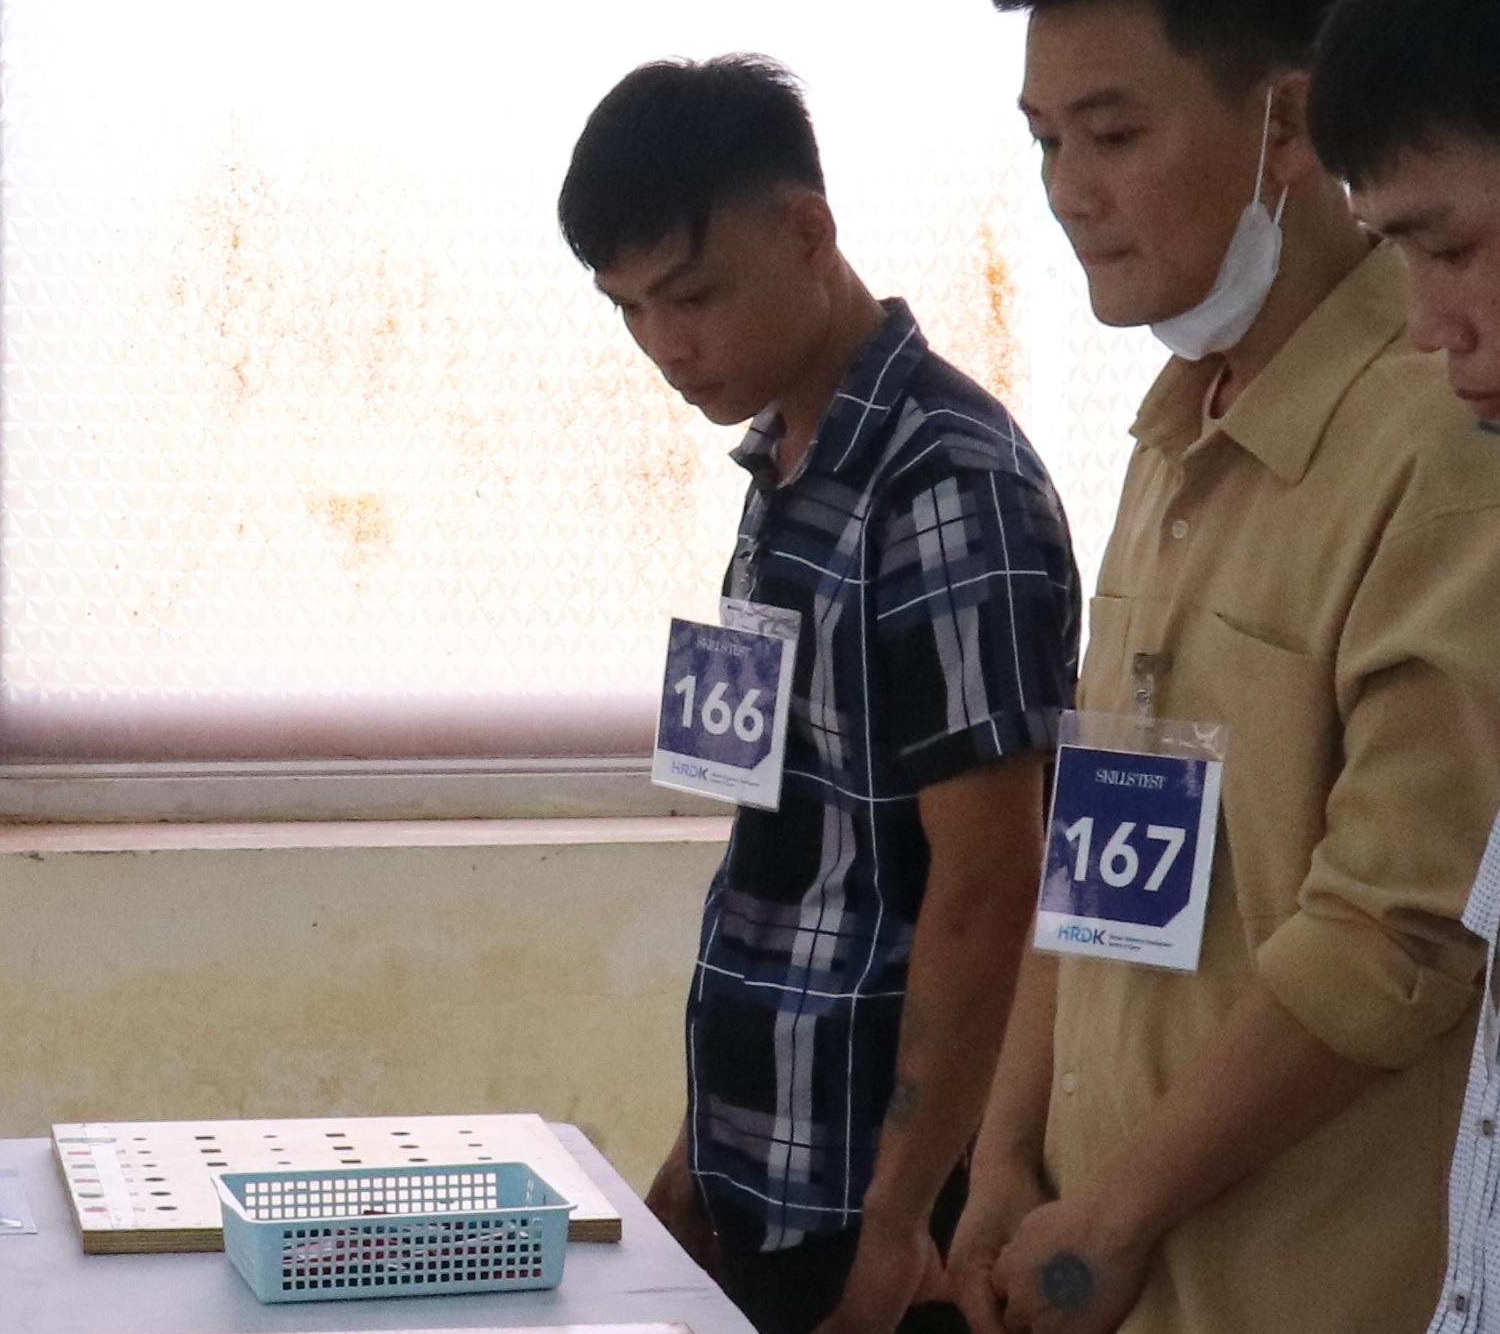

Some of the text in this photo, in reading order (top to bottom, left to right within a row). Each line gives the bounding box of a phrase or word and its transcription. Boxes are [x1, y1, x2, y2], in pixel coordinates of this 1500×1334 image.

[674, 674, 764, 743] 166
[1095, 769, 1166, 789] SKILLS TEST
[1065, 816, 1187, 892] 167
[1057, 923, 1106, 946] HRDK
